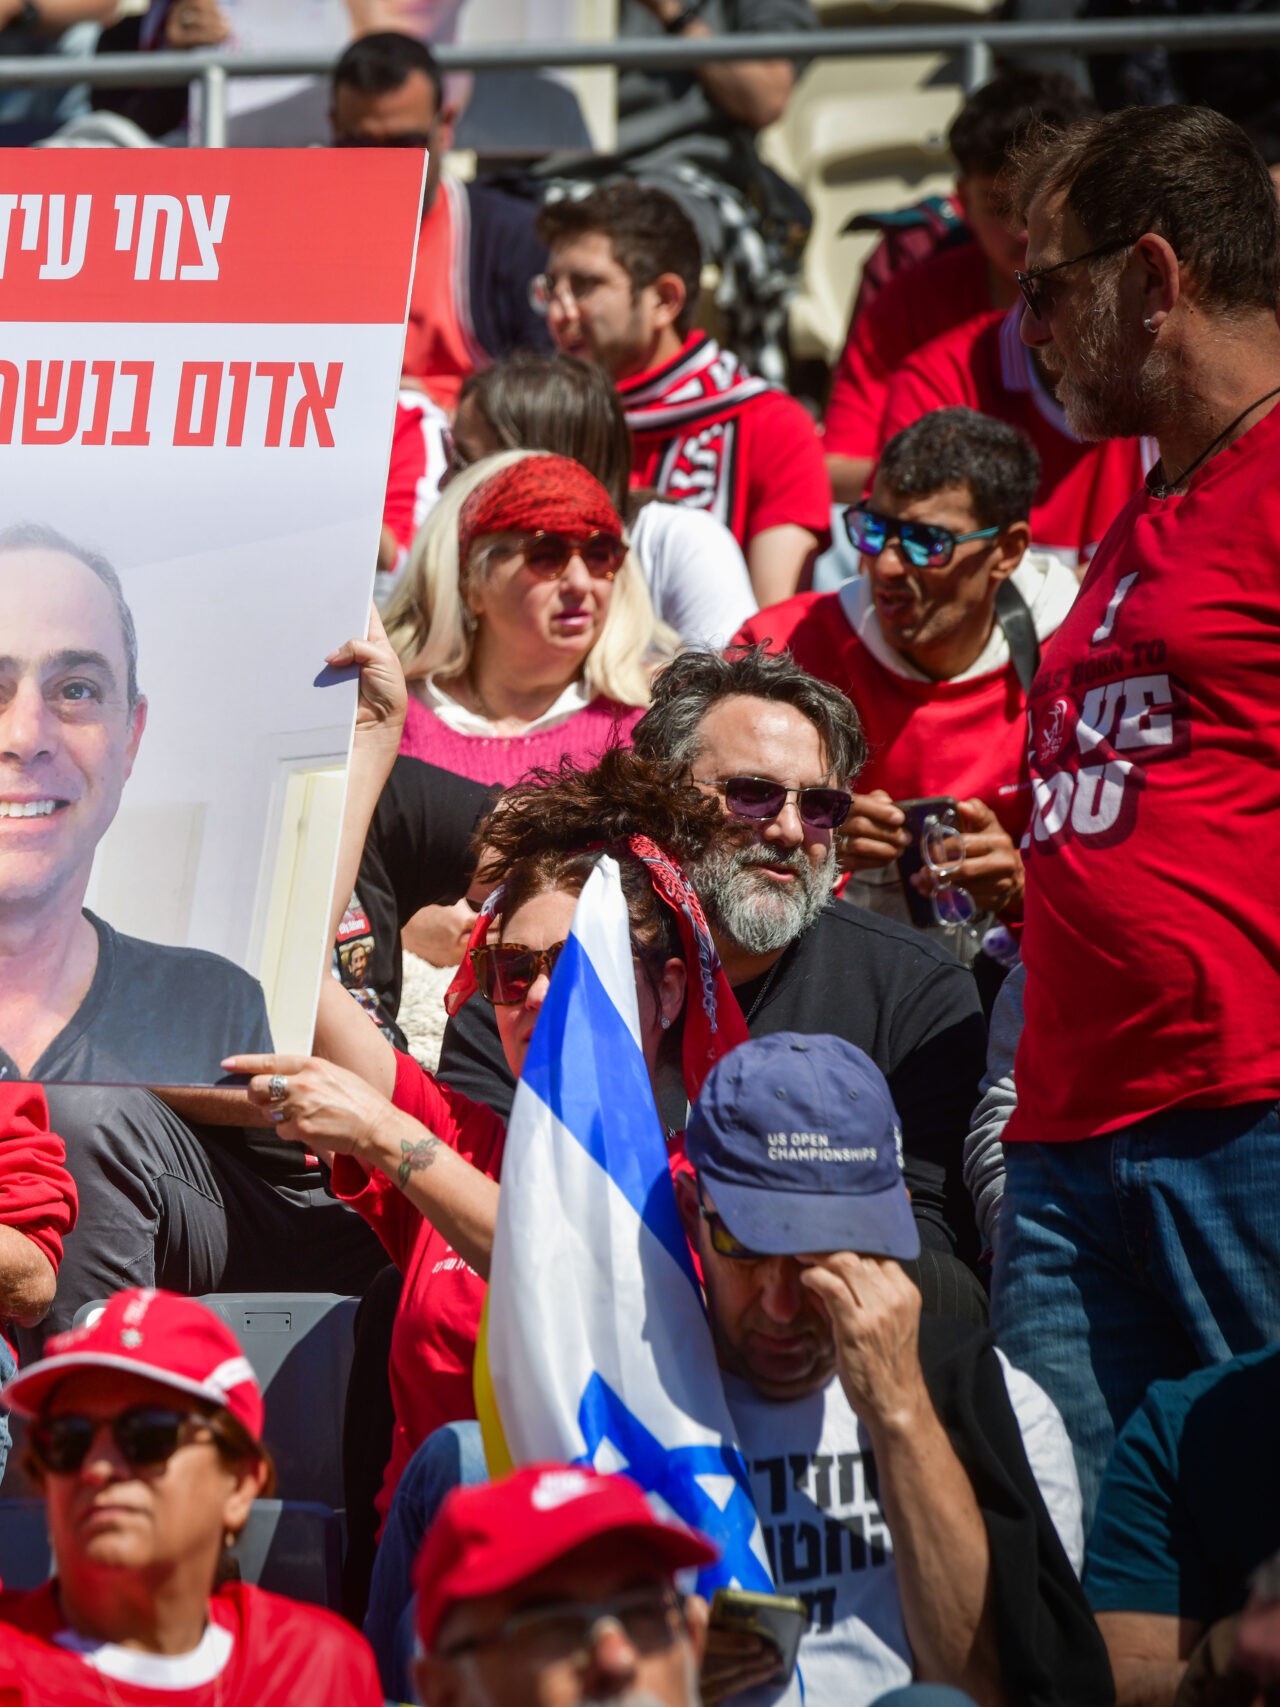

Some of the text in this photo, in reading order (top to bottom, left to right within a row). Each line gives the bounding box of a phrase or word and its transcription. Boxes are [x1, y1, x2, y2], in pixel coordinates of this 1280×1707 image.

[114, 194, 231, 281] צחי
[172, 360, 344, 448] אדום
[1131, 639, 1167, 669] TO
[1020, 761, 1126, 849] OU
[767, 1132, 829, 1148] US OPEN
[767, 1146, 878, 1162] CHAMPIONSHIPS
